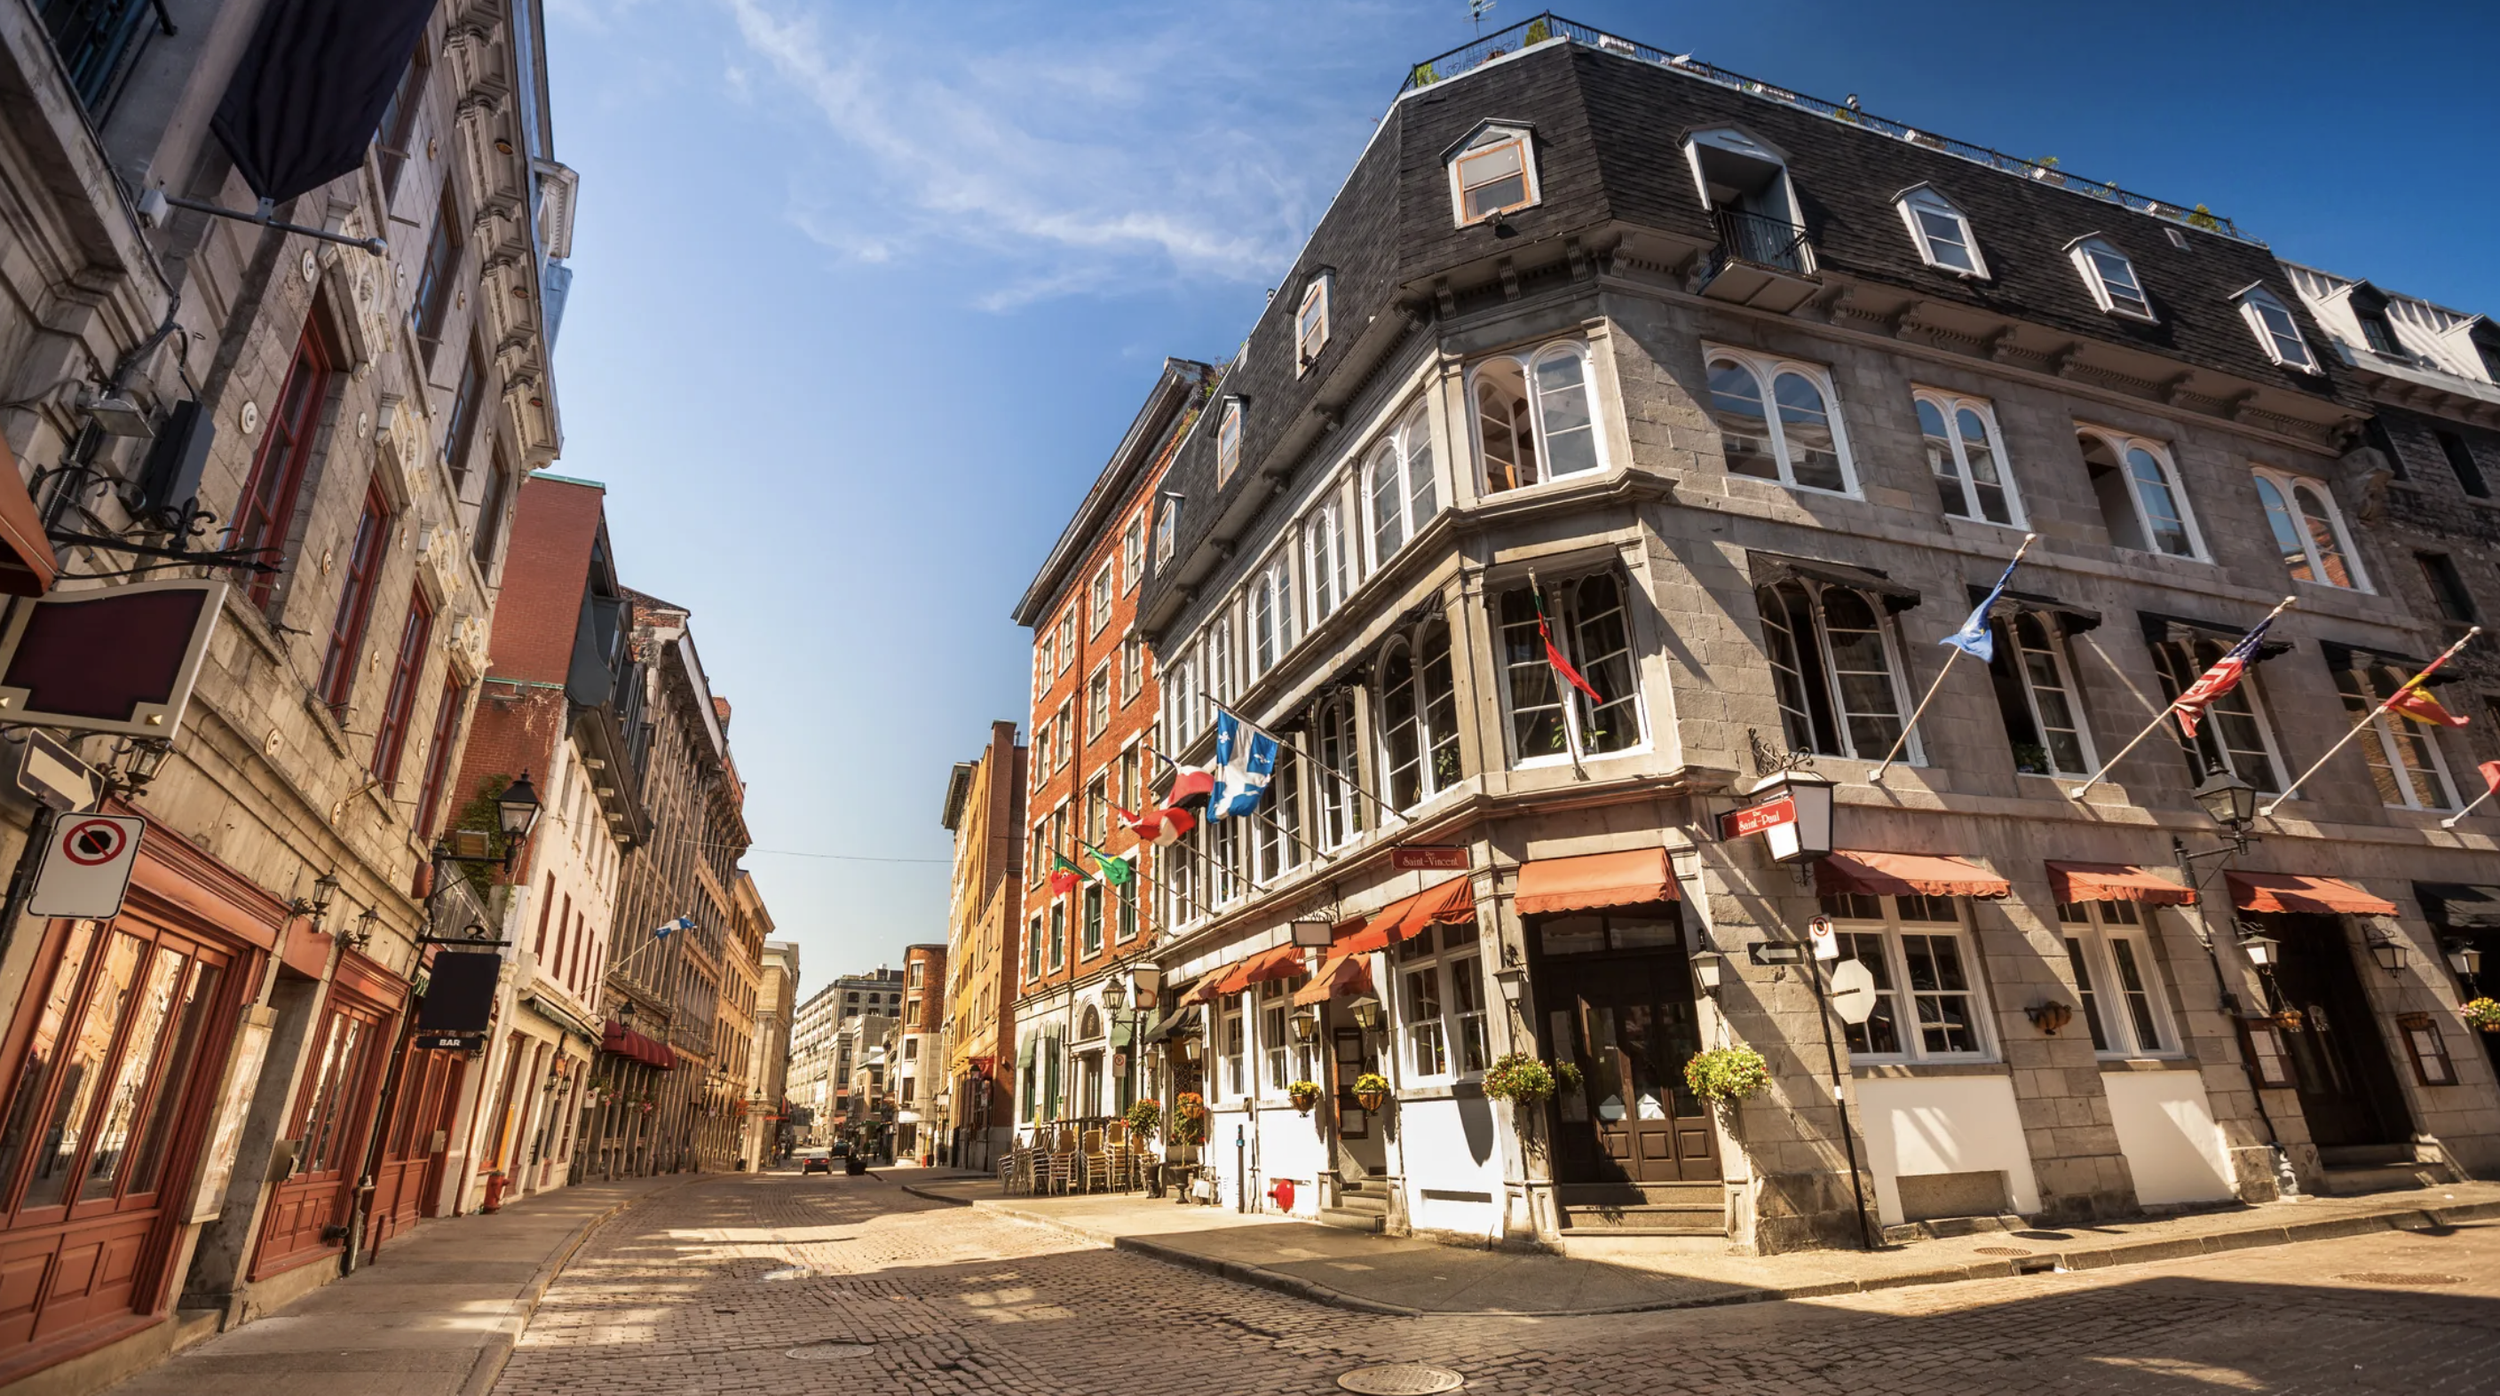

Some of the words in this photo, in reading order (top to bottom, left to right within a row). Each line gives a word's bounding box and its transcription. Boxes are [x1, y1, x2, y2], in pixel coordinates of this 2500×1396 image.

[1738, 810, 1780, 832] Saint-Paul
[1402, 856, 1459, 867] Saint-Vincent
[439, 1039, 461, 1047] BAR
